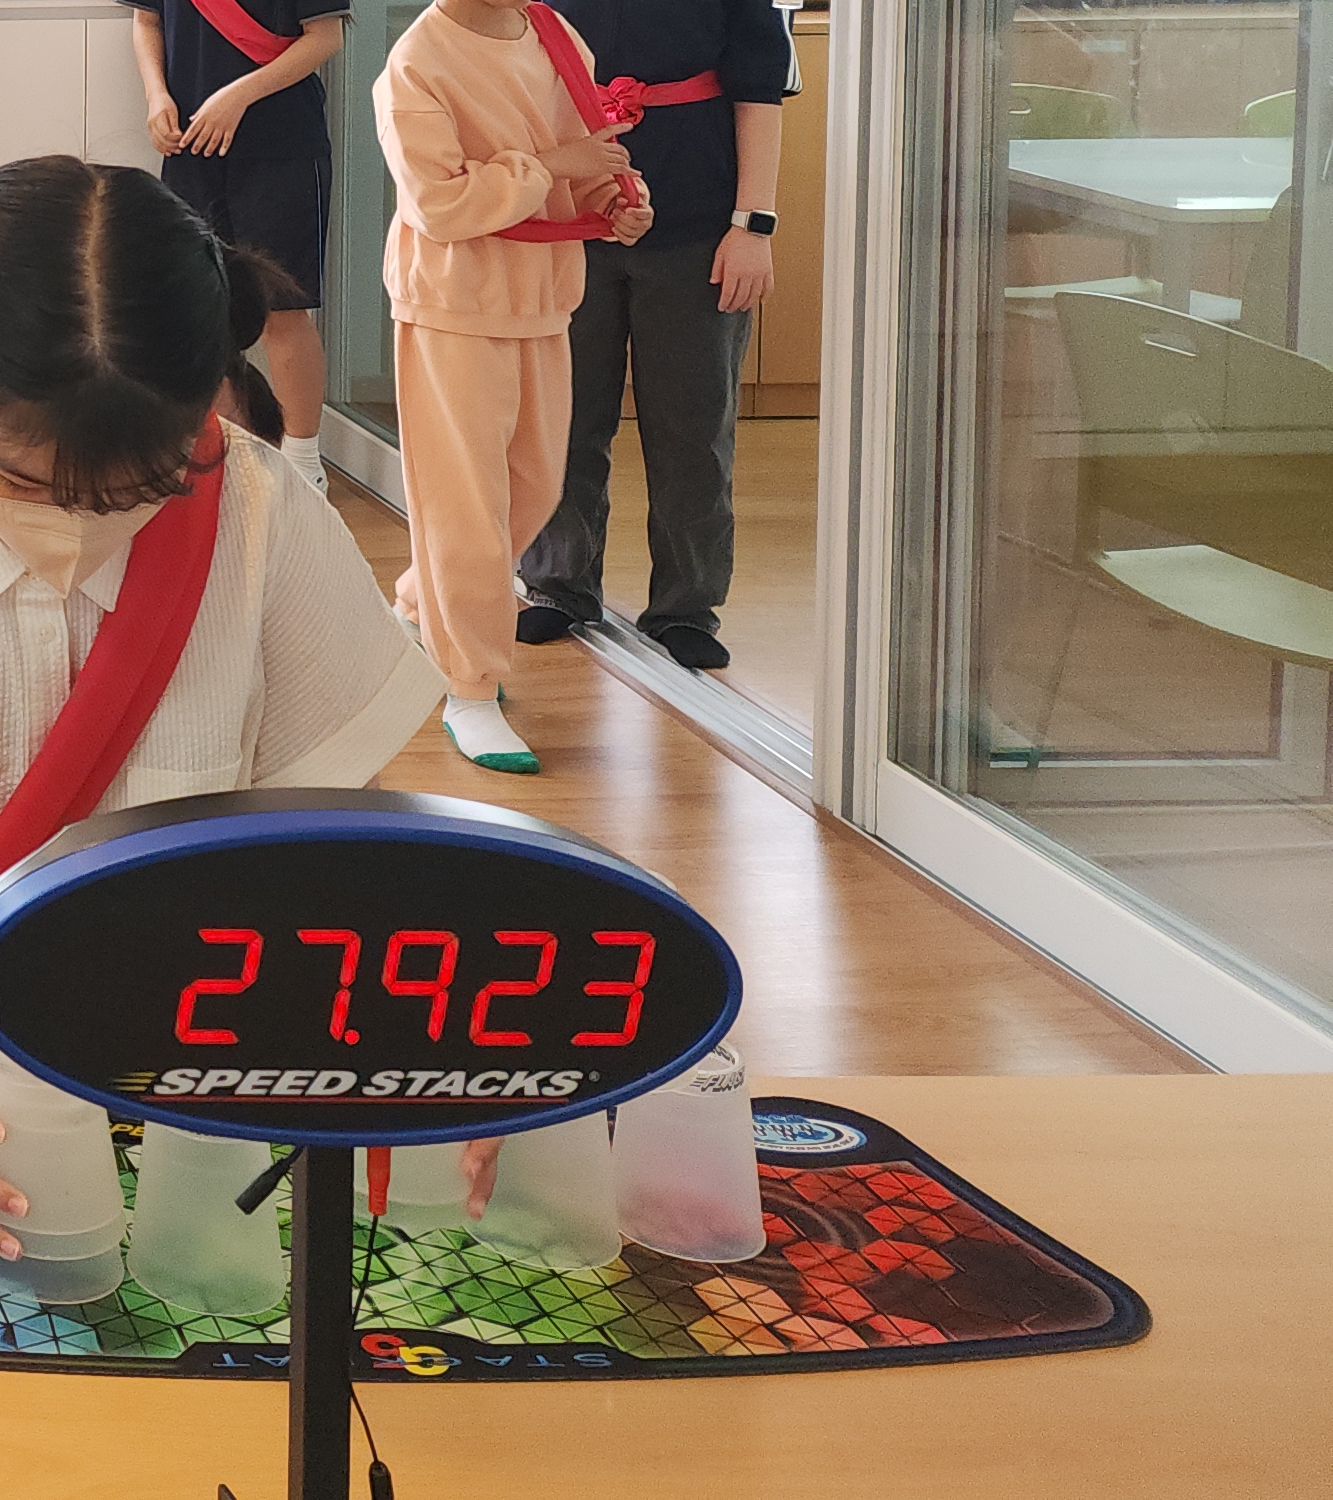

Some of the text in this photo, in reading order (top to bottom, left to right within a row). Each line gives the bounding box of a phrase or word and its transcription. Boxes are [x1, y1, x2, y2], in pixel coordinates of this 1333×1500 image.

[174, 927, 657, 1046] 27.923
[153, 1069, 581, 1097] SPEED STACKS
[212, 1352, 291, 1368] AT
